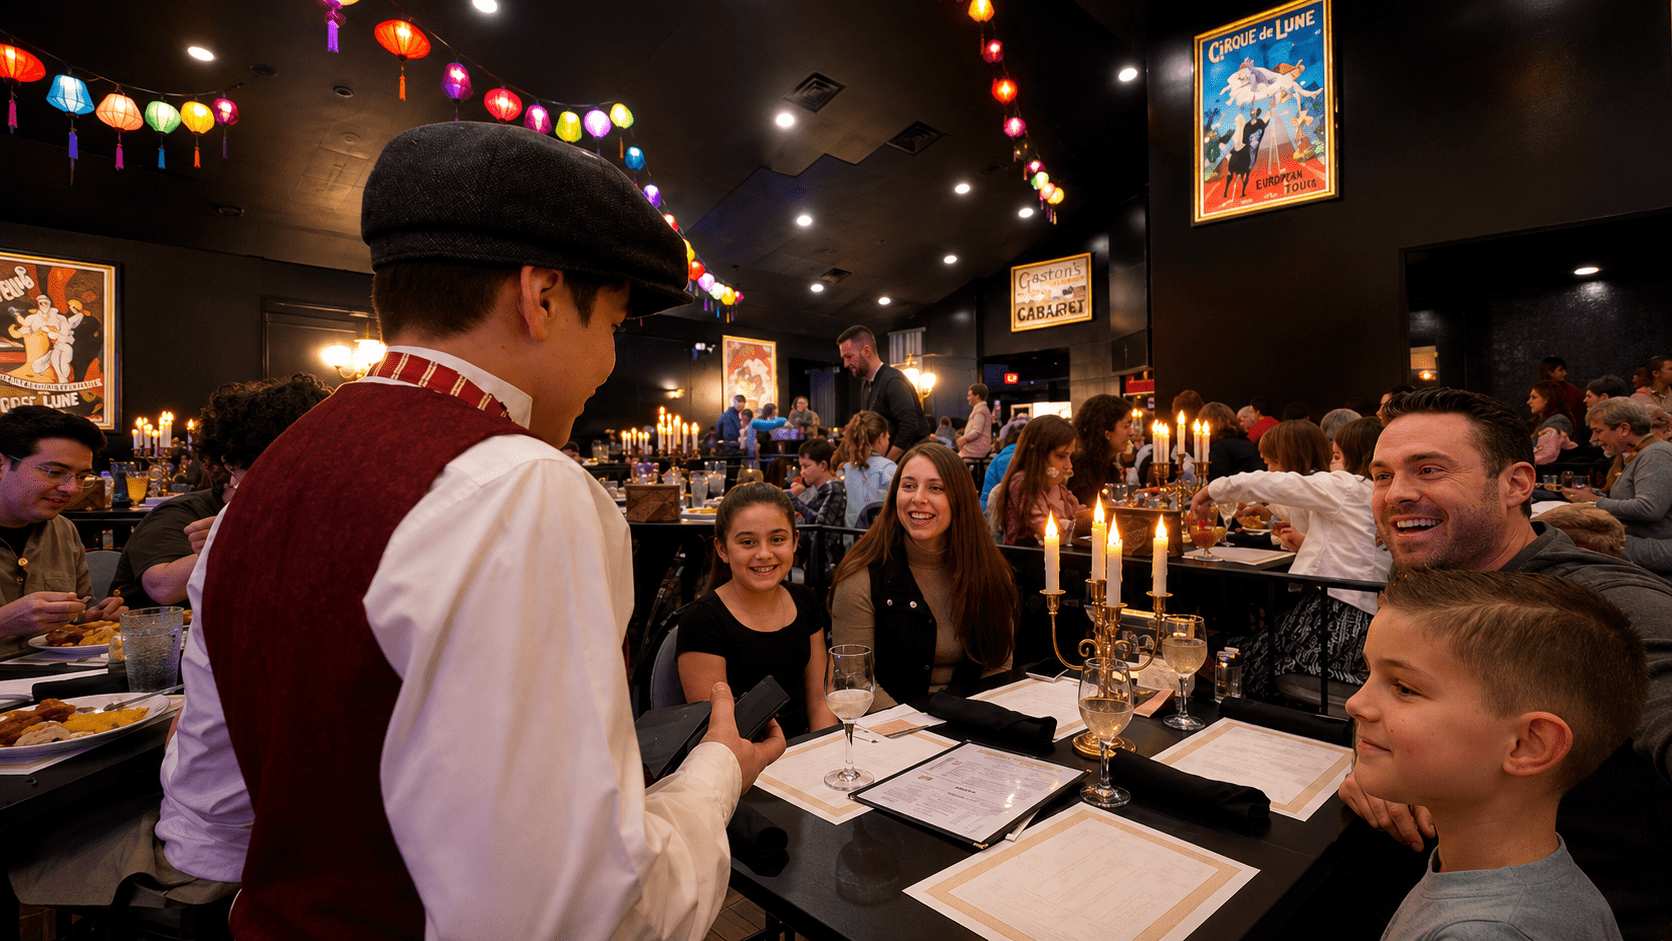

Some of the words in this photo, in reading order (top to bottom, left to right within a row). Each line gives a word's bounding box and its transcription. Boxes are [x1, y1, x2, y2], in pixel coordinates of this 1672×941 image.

[1259, 26, 1273, 40] de
[1275, 9, 1315, 40] LUNE
[1017, 299, 1085, 321] CABARET
[43, 391, 79, 408] LUNE
